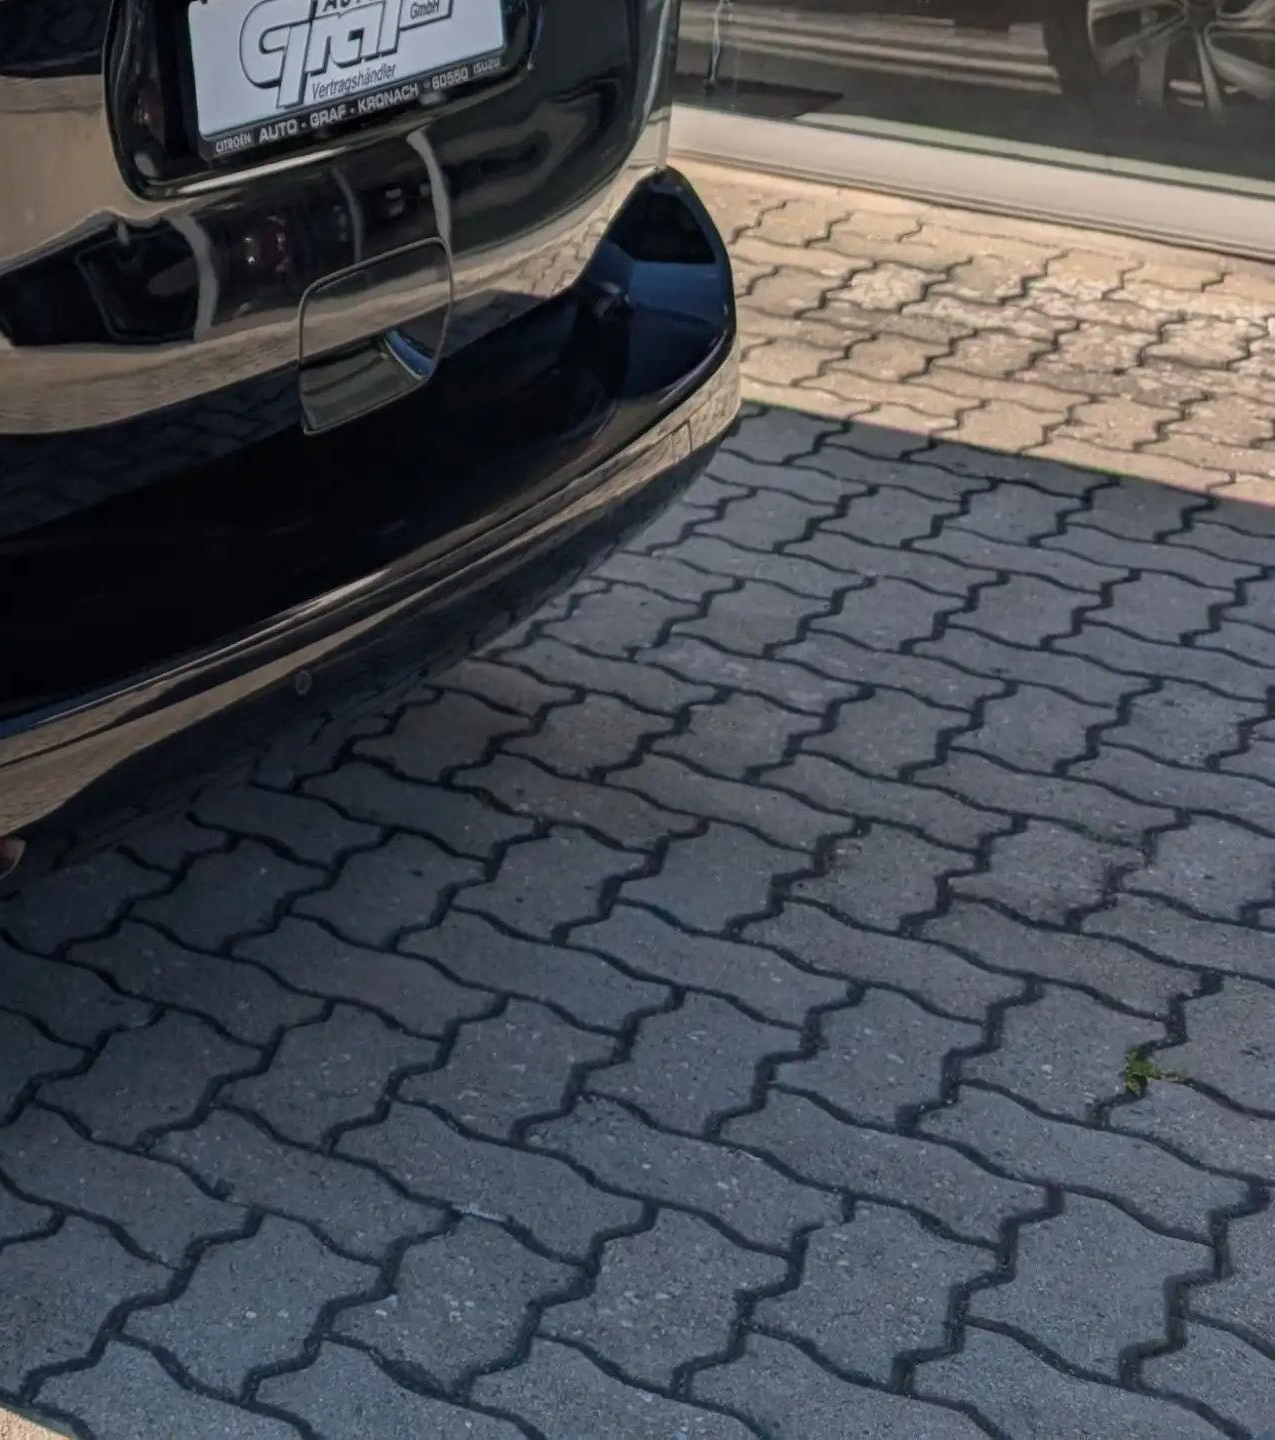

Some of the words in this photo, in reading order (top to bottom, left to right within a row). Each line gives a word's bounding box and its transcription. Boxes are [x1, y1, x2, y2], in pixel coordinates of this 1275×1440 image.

[312, 62, 397, 101] Vertragshändler
[259, 118, 298, 144] AUTO
[310, 104, 347, 129] GRAF
[358, 82, 419, 113] KRONACH
